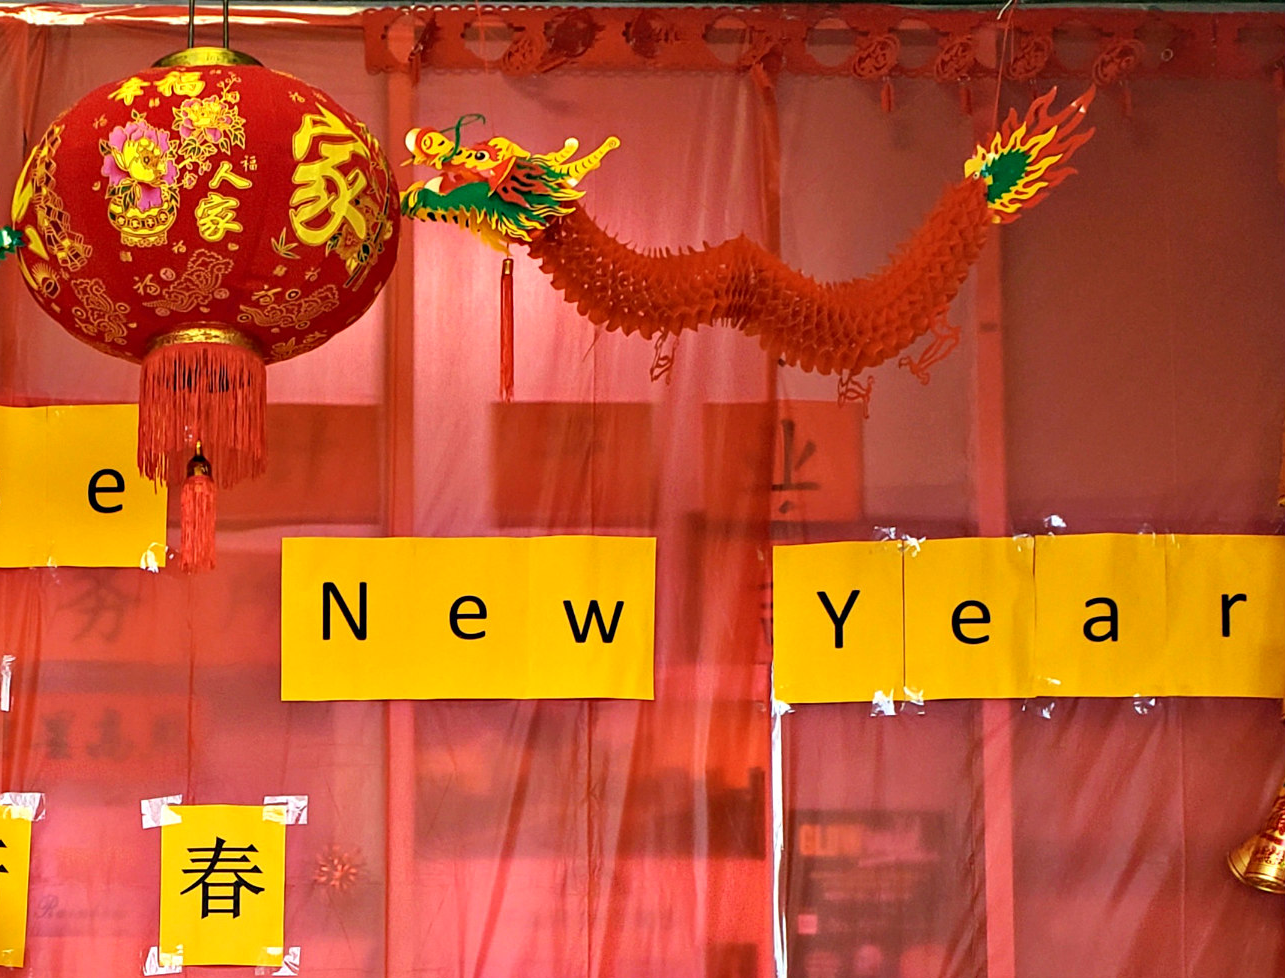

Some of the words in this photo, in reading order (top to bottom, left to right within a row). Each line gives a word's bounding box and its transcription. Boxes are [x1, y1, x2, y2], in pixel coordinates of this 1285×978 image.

[108, 71, 205, 105] 幸福
[195, 161, 253, 242] 人家
[289, 101, 372, 246] 家
[321, 581, 625, 644] New
[816, 588, 1248, 650] Year
